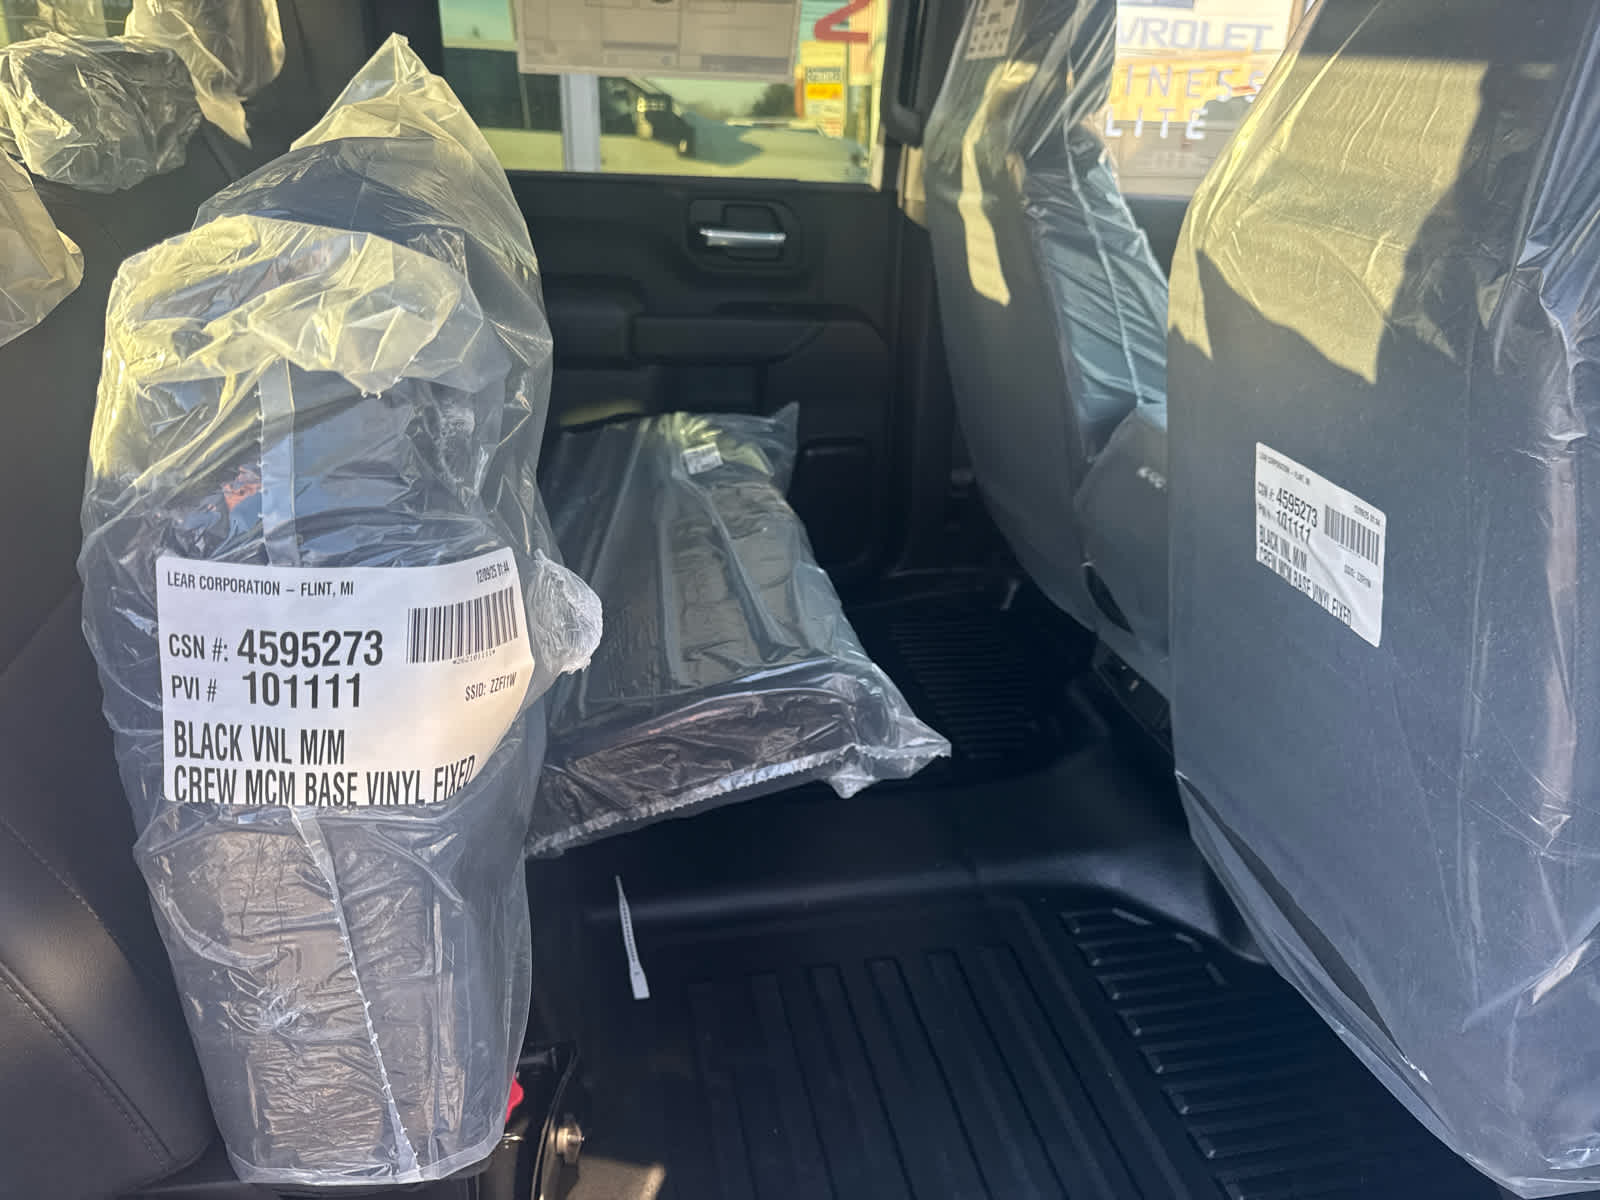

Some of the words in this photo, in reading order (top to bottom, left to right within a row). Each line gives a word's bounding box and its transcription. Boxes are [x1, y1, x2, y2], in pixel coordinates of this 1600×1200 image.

[1276, 487, 1318, 528] 4595273
[1276, 510, 1311, 545] 101111
[167, 571, 196, 589] LEAR
[199, 575, 280, 596] CORPORATION
[300, 581, 337, 598] FLINT,
[340, 581, 354, 596] MI
[169, 633, 205, 660] CSN
[212, 637, 228, 662] #:
[237, 629, 384, 668] 4595273
[171, 674, 200, 701] PVI
[206, 678, 217, 703] #
[242, 670, 362, 709] 101111
[465, 682, 486, 702] SSID:
[174, 720, 243, 762] BLACK
[251, 725, 292, 764] VNL
[300, 729, 345, 765] M/M
[174, 764, 237, 805] CREW
[245, 769, 296, 805] MCM
[305, 771, 358, 806] BASE
[366, 770, 426, 806] VINYL
[433, 754, 476, 802] FIXED
